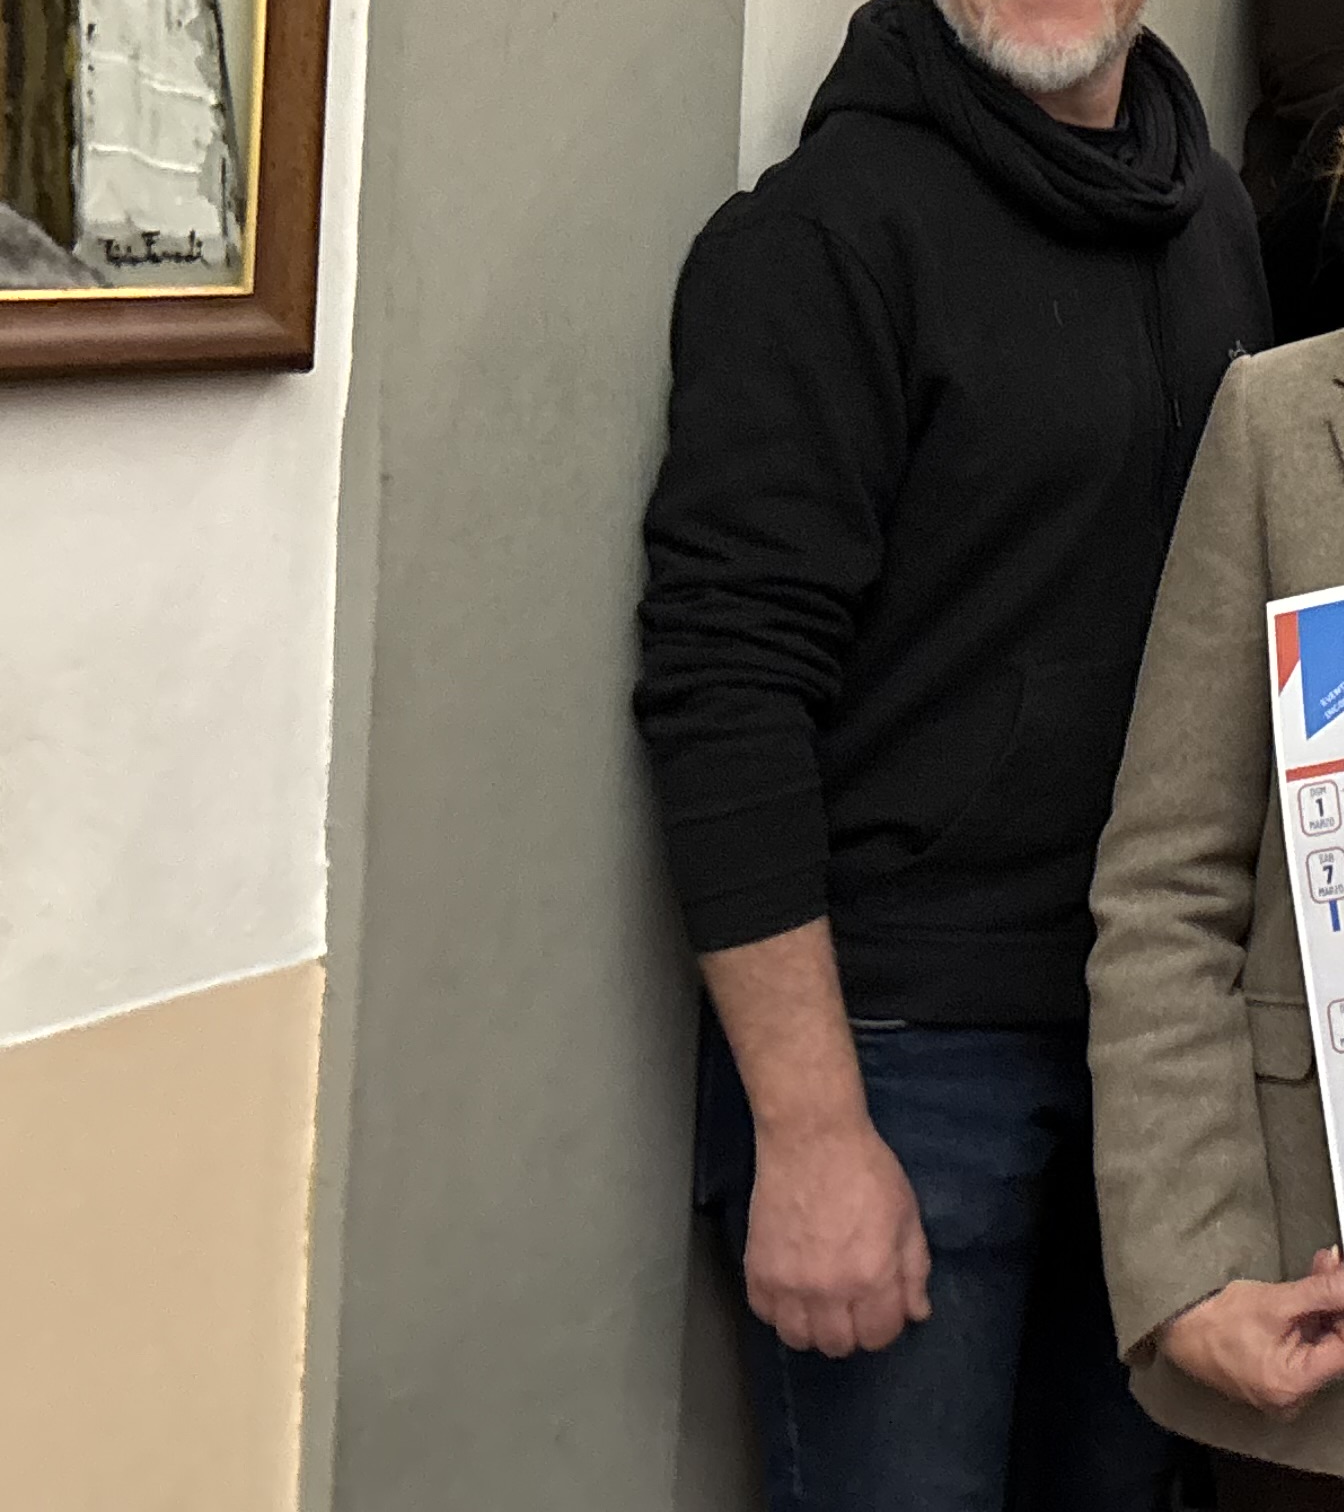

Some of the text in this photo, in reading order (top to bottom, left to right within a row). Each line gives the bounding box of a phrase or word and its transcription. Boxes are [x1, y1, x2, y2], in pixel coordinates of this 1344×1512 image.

[1315, 798, 1324, 818] 1
[1309, 816, 1335, 830] MARZO
[1322, 864, 1334, 884] 7
